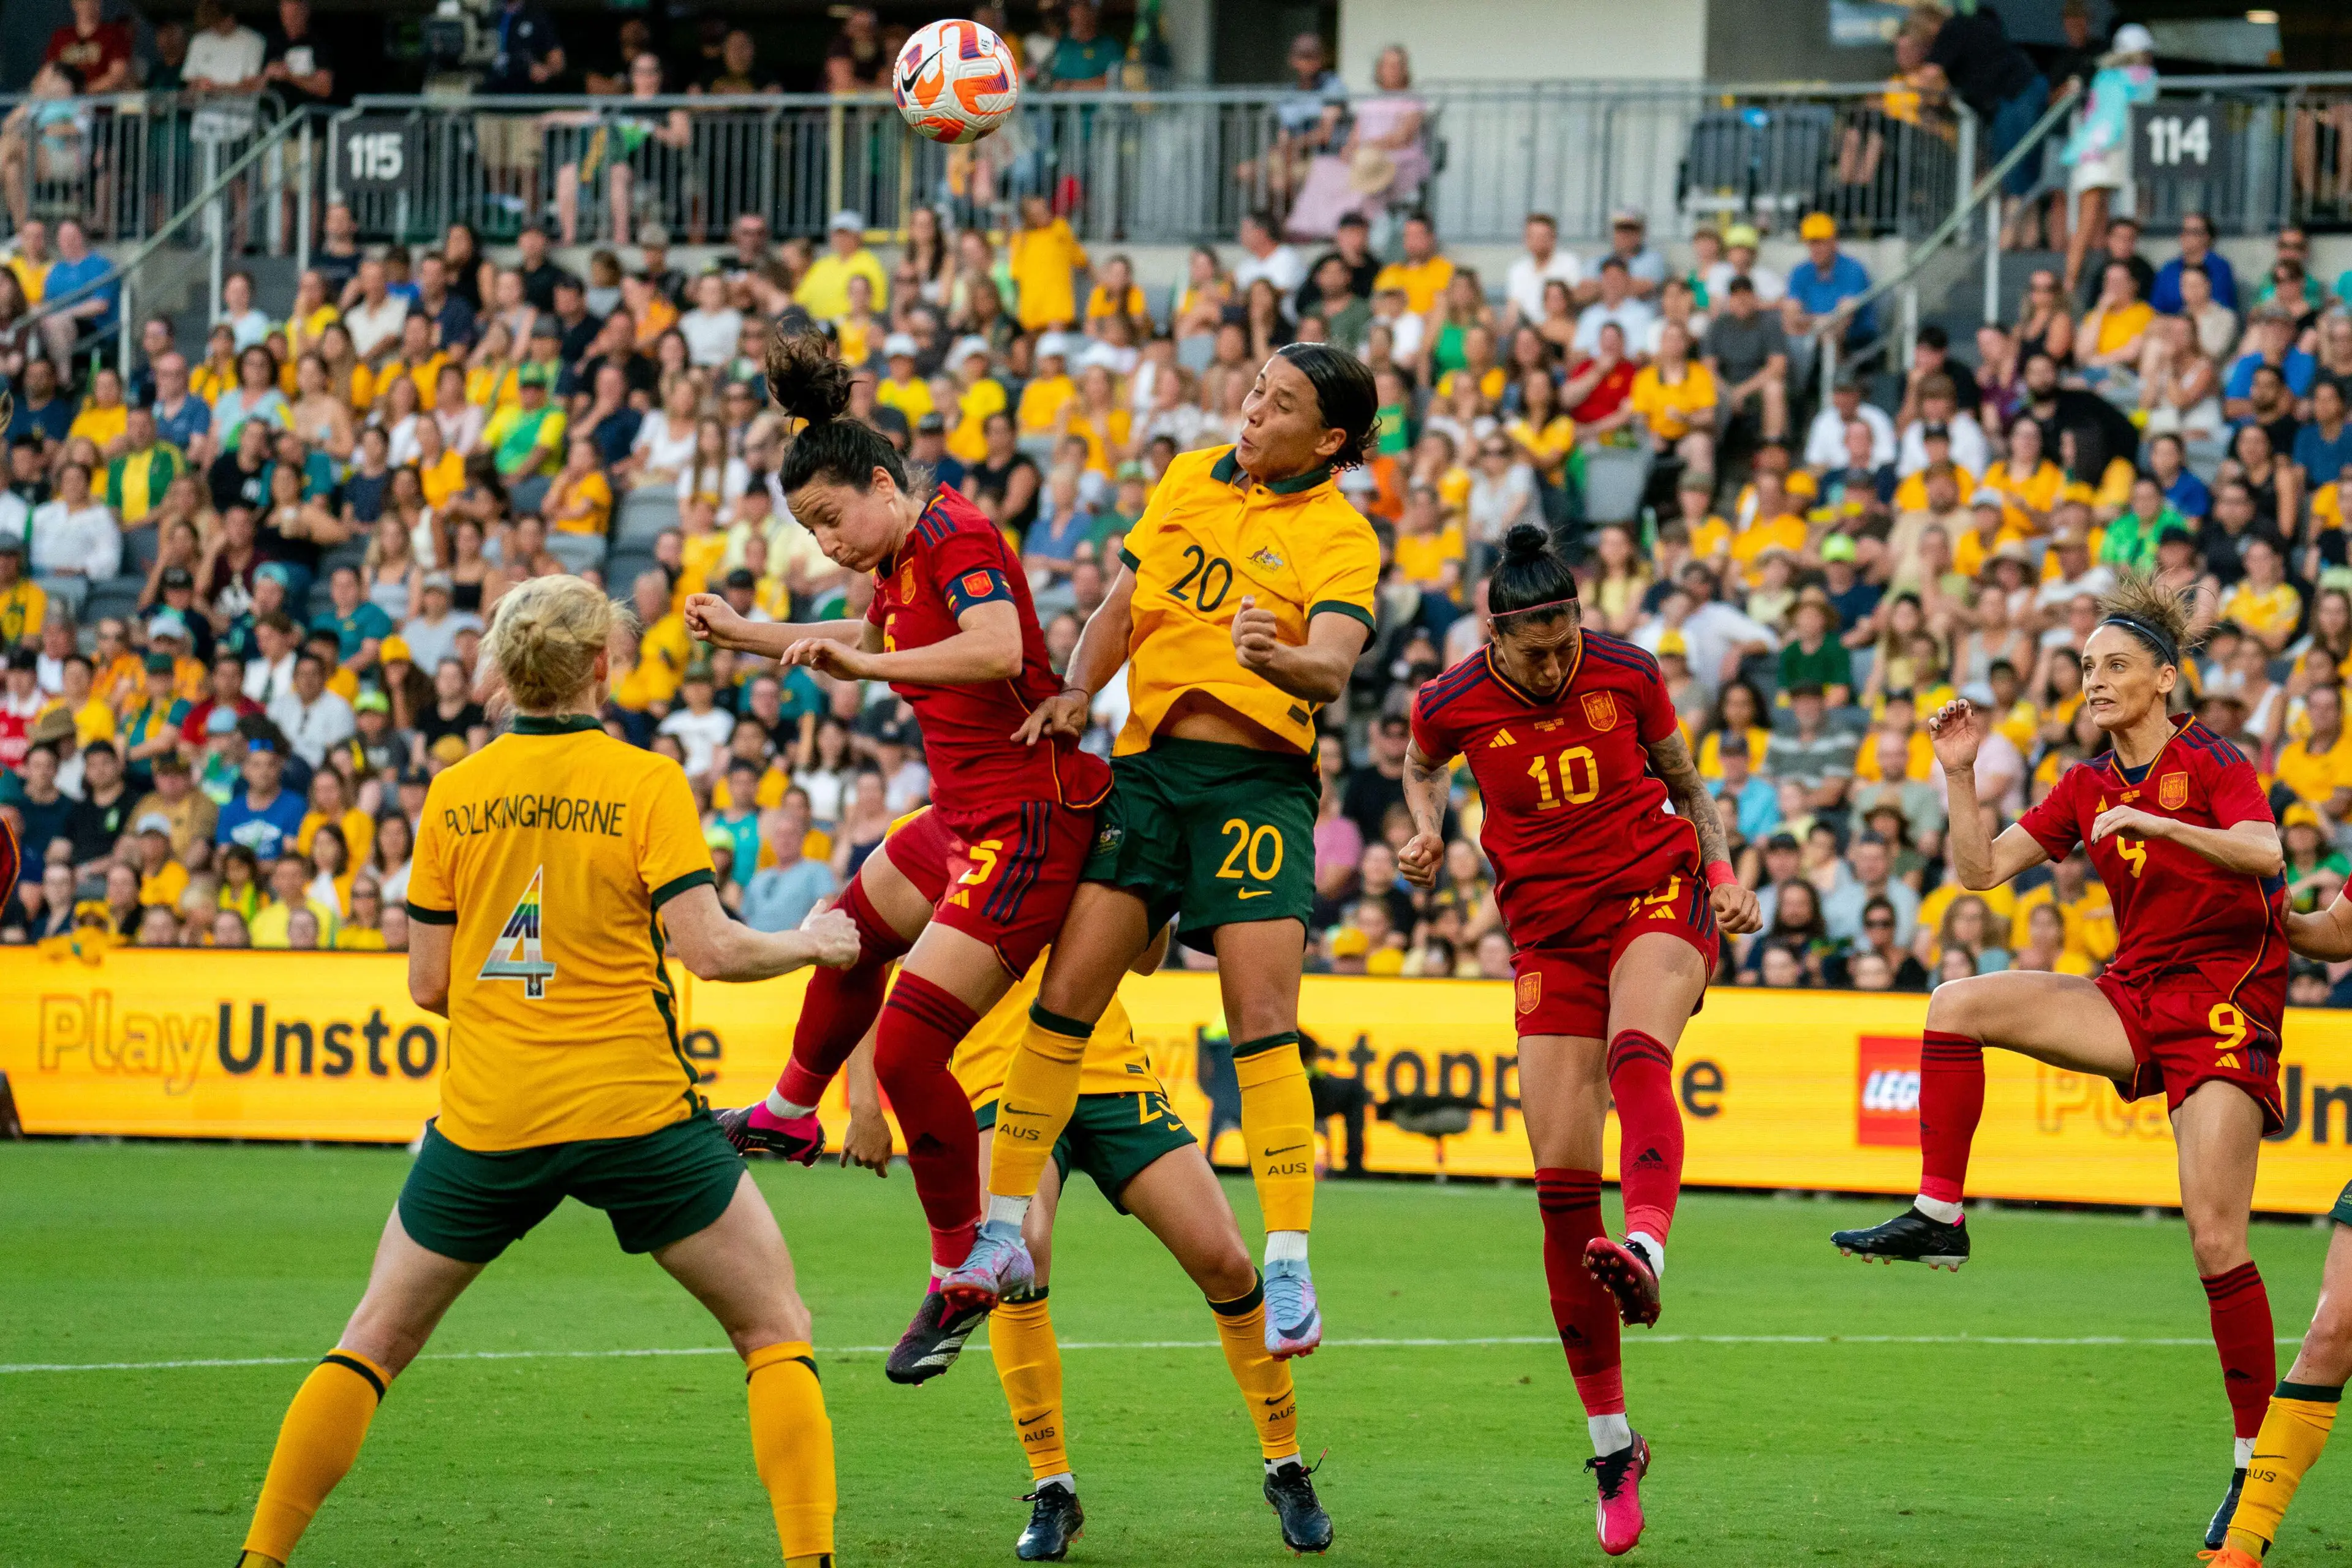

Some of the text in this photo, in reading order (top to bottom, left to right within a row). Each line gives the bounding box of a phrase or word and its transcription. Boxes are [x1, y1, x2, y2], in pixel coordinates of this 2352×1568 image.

[349, 133, 405, 181] 115
[2147, 116, 2210, 167] 114
[1166, 545, 1233, 612] 20
[1527, 745, 1600, 811] 10
[957, 840, 1004, 886] 5
[1215, 818, 1284, 881] 20
[477, 864, 557, 1000] 4
[2207, 1002, 2247, 1049] 9
[1862, 1069, 1920, 1111] LEG
[999, 1123, 1041, 1141] AUS
[1268, 1162, 1307, 1176] AUS
[1023, 1426, 1055, 1443] AUS
[1267, 1401, 1297, 1422] AUS
[2245, 1468, 2277, 1483] AUS
